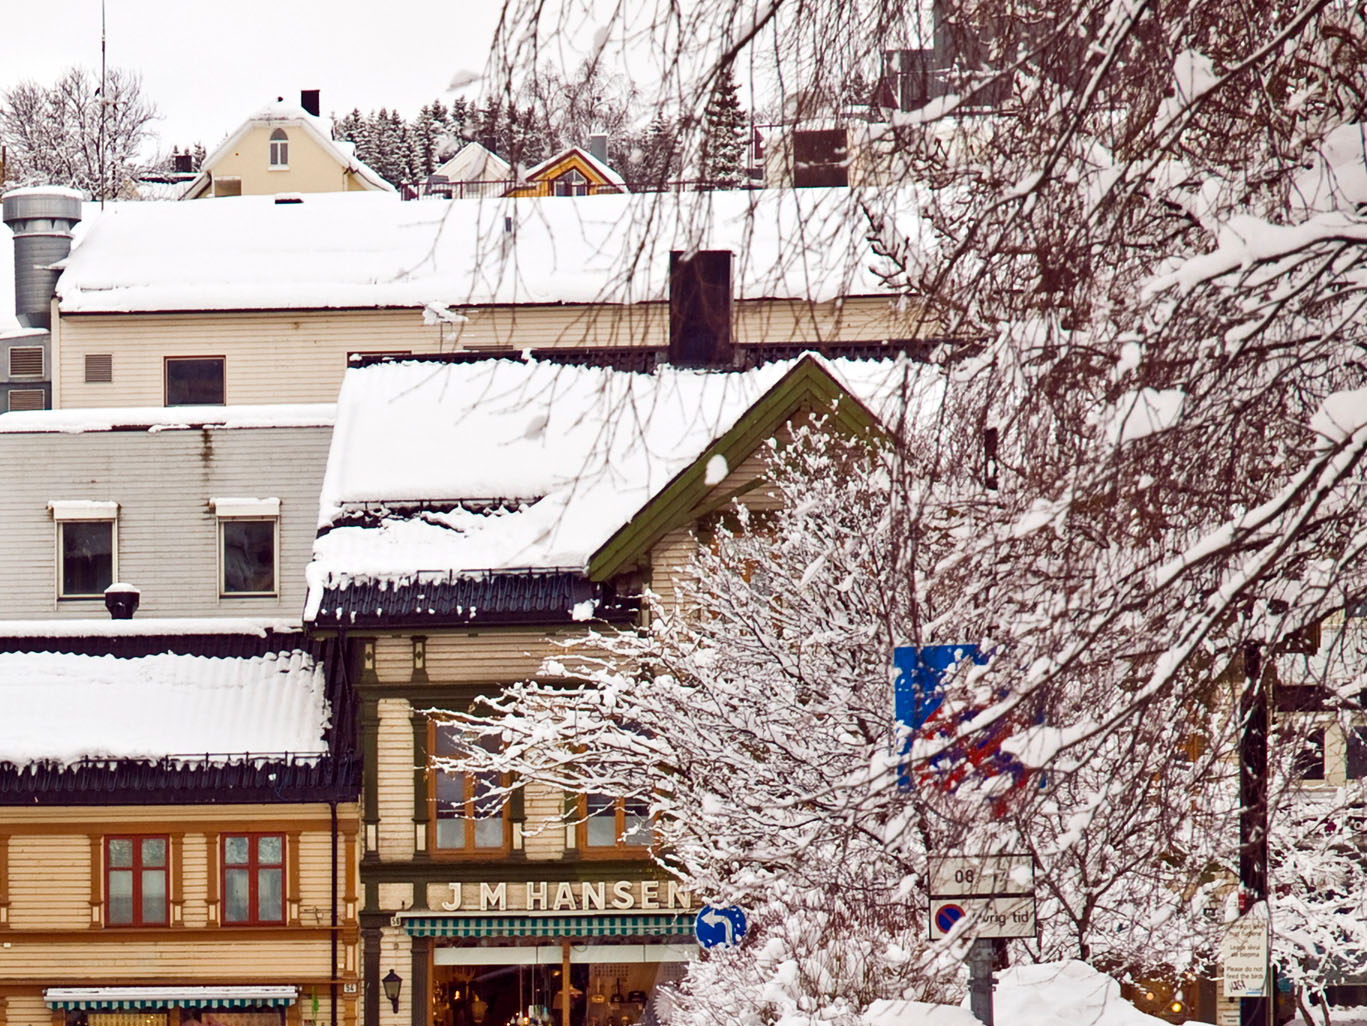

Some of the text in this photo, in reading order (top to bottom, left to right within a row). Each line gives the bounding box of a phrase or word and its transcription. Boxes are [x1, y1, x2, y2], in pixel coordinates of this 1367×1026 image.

[441, 880, 692, 911] J M HANSEN
[1013, 911, 1029, 923] tid
